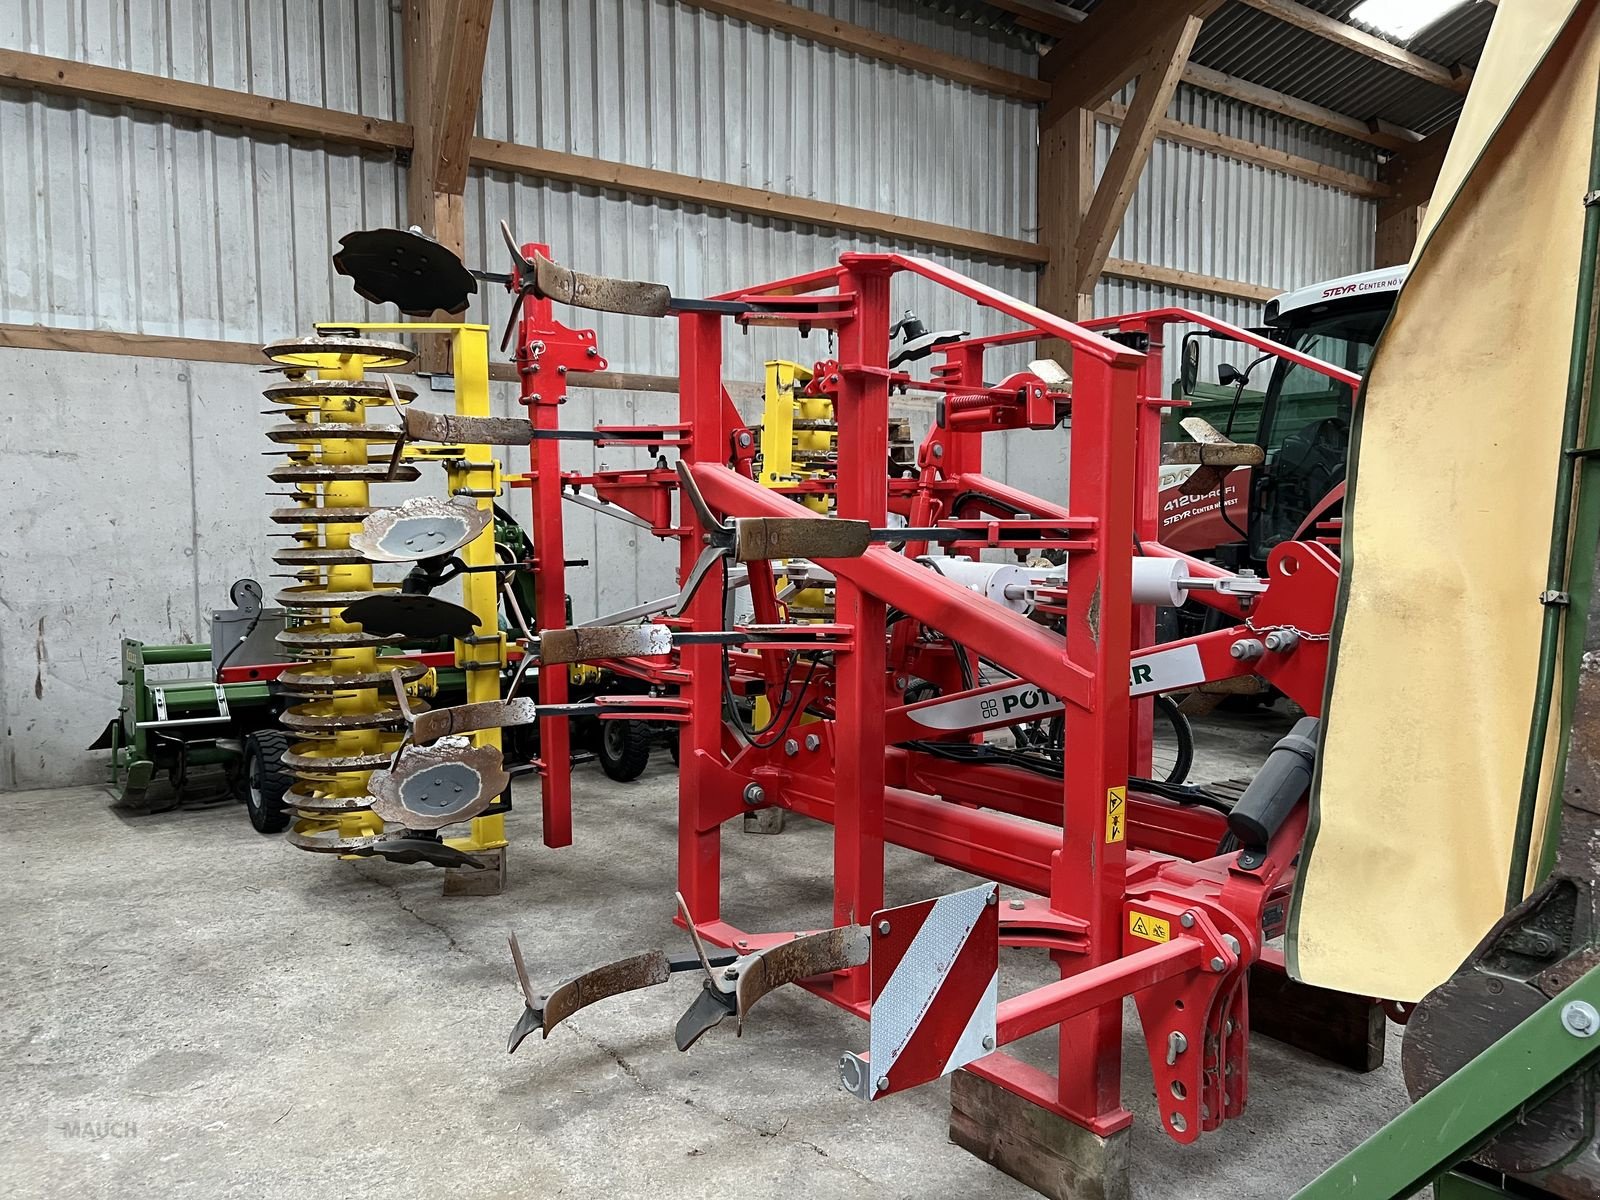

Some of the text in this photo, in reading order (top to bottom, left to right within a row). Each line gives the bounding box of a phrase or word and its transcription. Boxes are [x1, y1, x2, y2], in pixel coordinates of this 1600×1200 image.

[1322, 284, 1356, 298] STEYR
[1359, 282, 1386, 291] CENTER
[1159, 468, 1192, 485] TEYR
[1164, 511, 1191, 526] STEYR
[1192, 504, 1214, 515] CENTER
